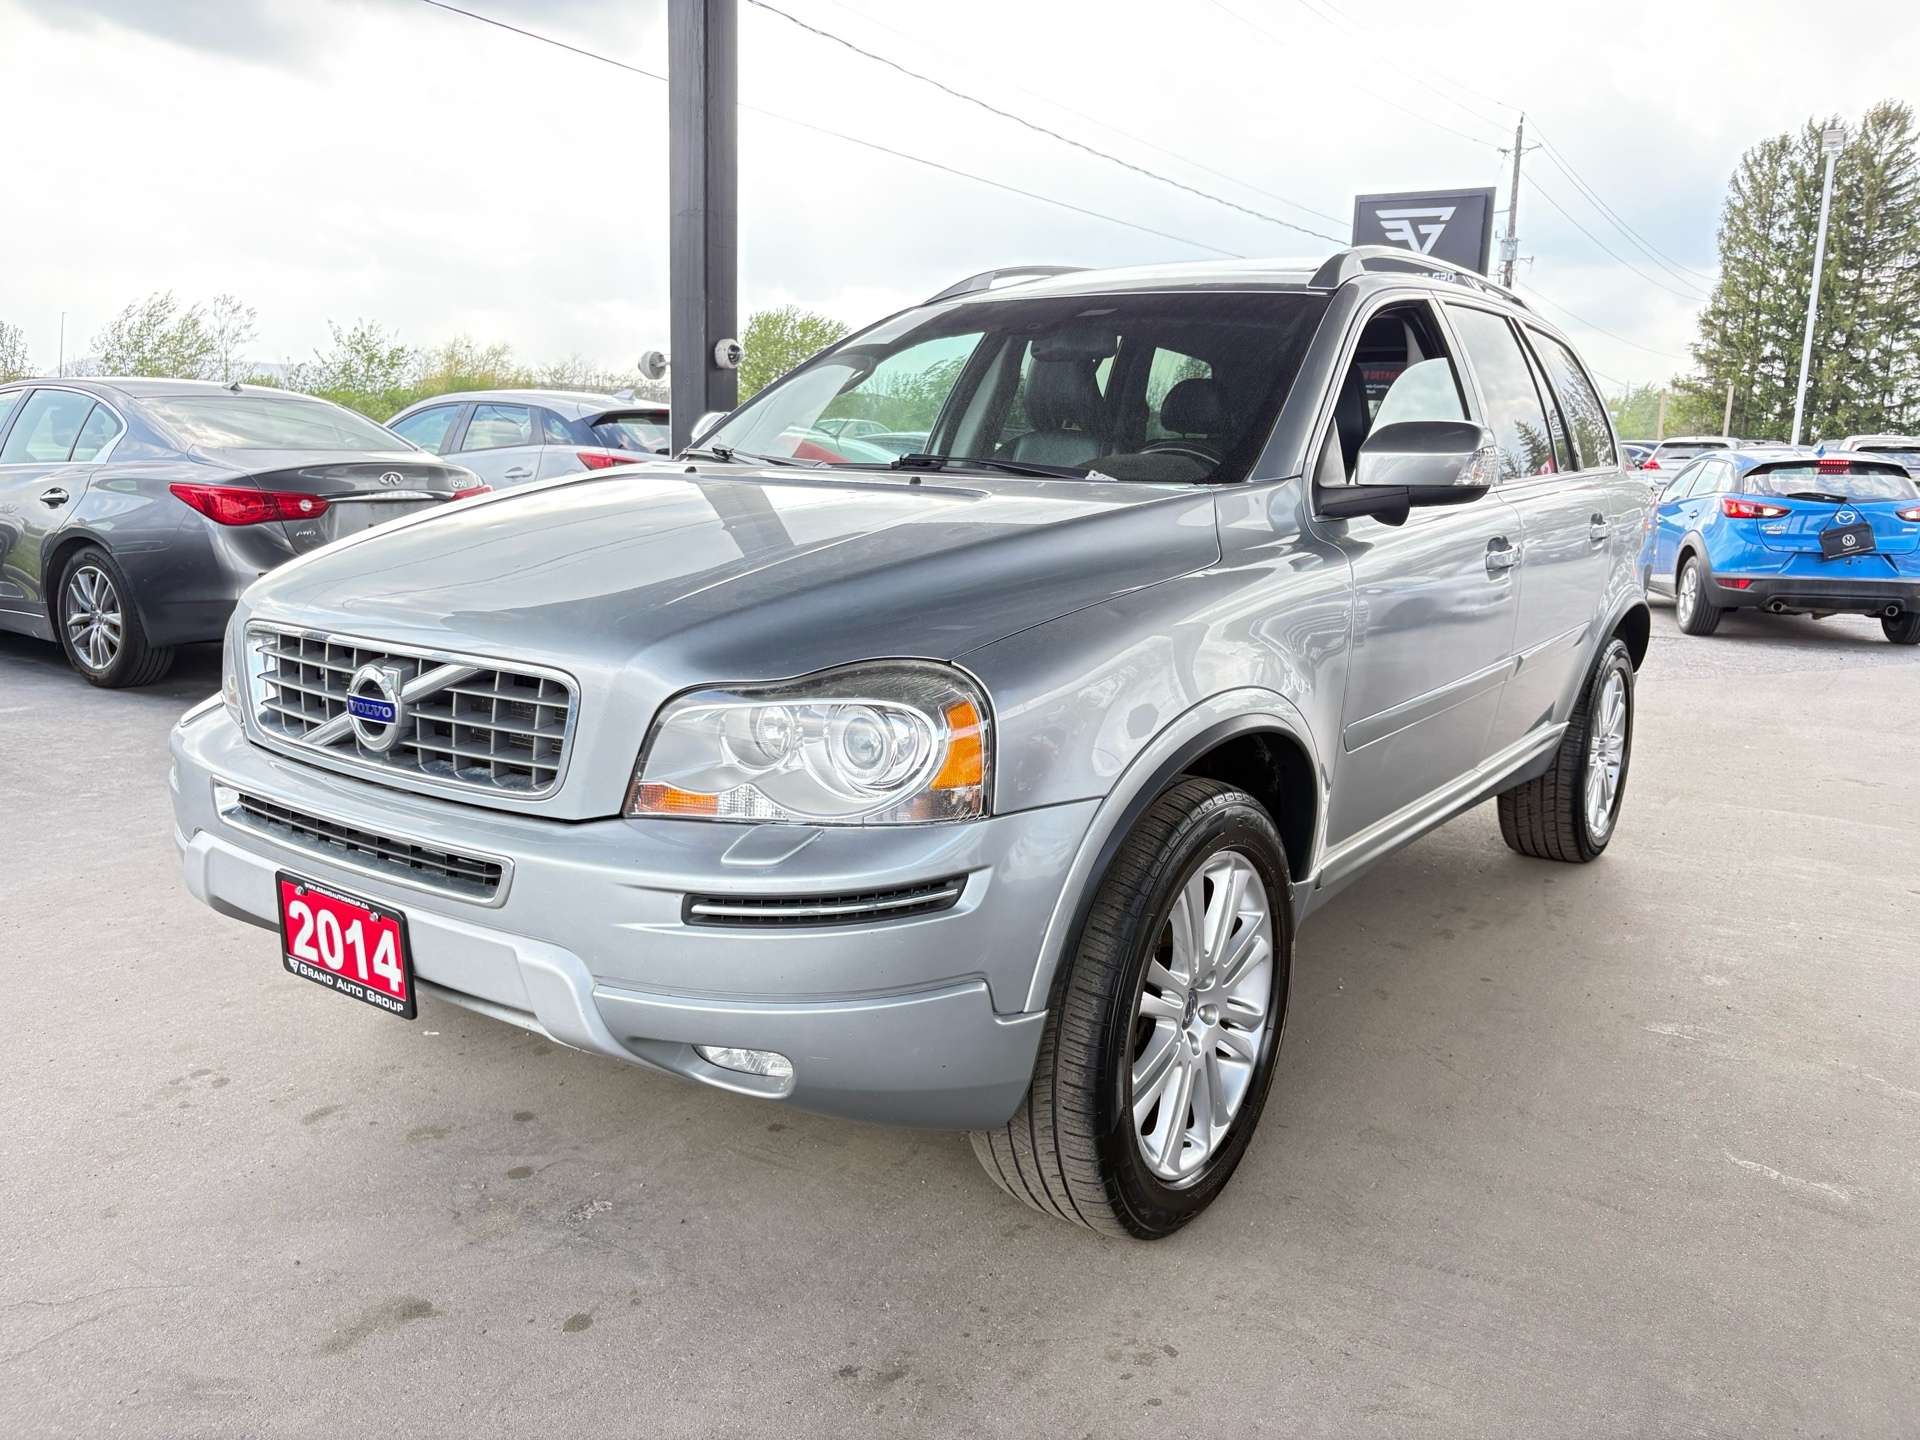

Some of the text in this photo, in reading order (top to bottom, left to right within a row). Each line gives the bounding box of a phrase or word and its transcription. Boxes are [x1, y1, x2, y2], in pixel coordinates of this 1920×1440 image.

[348, 698, 393, 719] VOLVO
[288, 900, 402, 992] 2014
[299, 964, 404, 1012] GRAND AUTO GROUP
